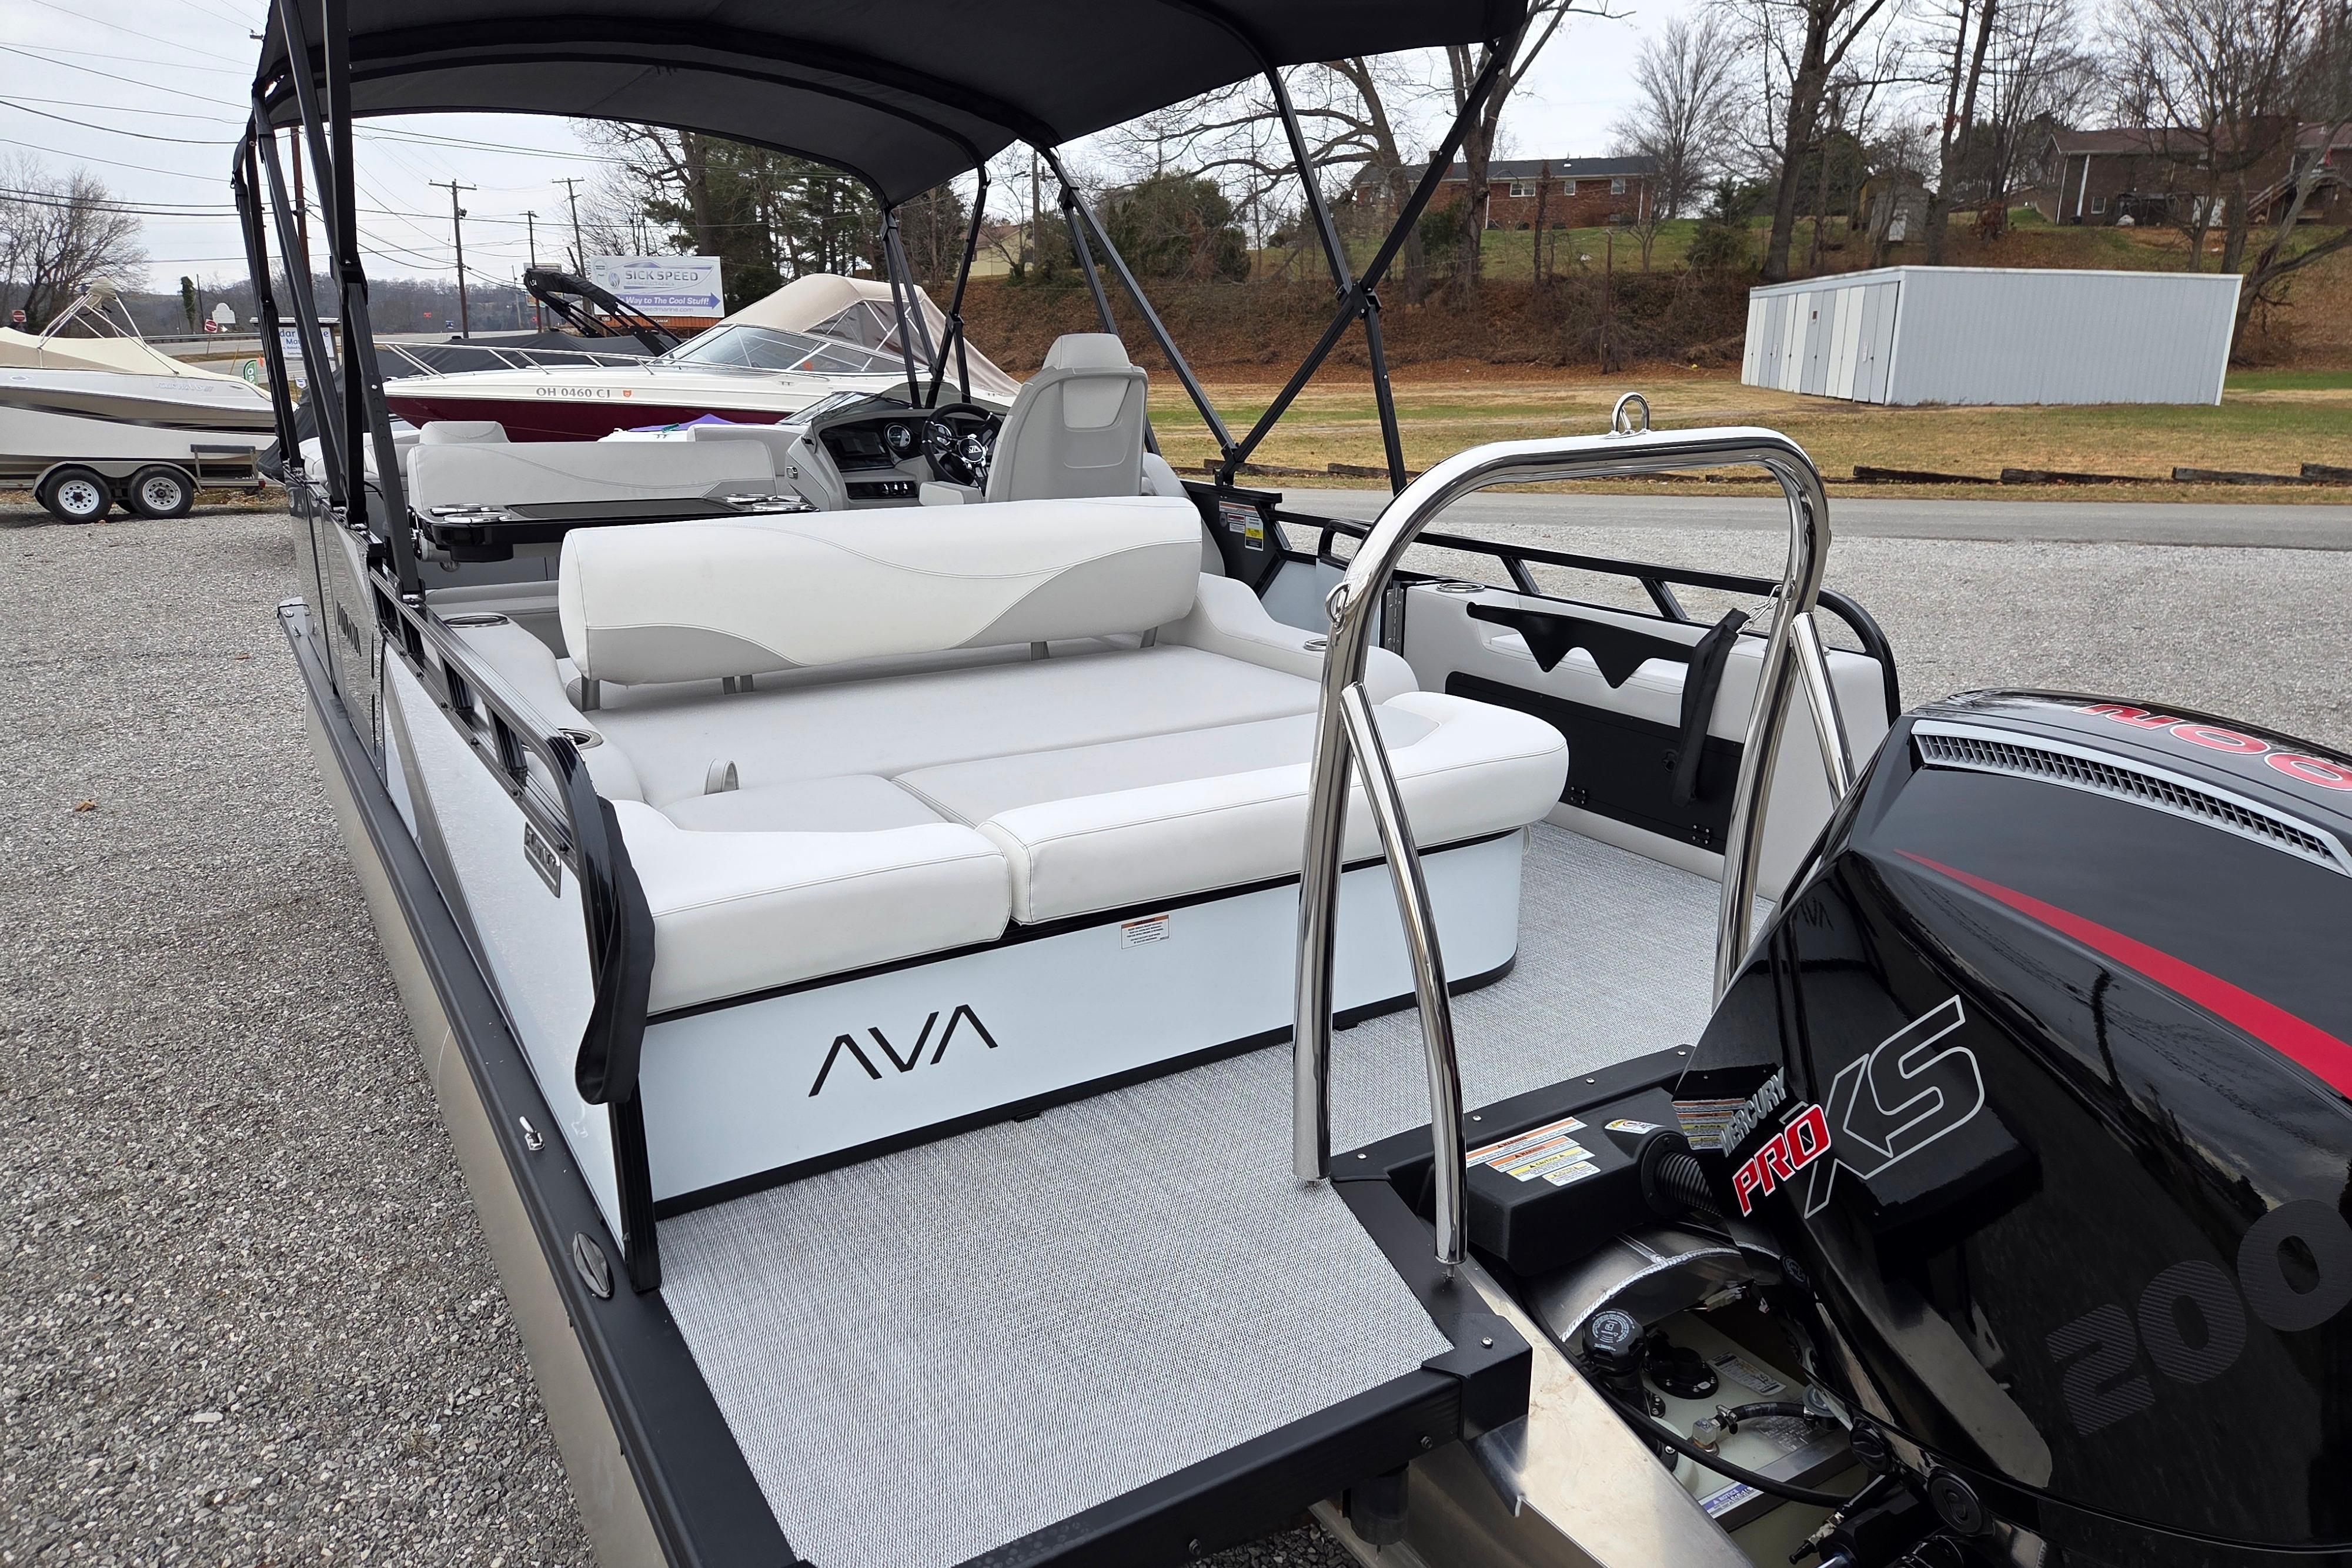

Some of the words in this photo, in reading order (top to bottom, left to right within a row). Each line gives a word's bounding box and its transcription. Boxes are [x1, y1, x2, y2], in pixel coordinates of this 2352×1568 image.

[625, 270, 654, 280] SICK
[657, 271, 699, 281] SPEED
[626, 296, 643, 305] Way
[687, 297, 709, 305] Stuff!
[279, 329, 295, 337] dar
[536, 387, 556, 396] OH
[561, 388, 592, 397] 0460
[596, 389, 610, 398] CJ
[808, 1004, 998, 1098] AVA
[1720, 1066, 1786, 1158] MERCURY
[1779, 995, 1985, 1219] XS
[1502, 1136, 1528, 1147] WARNING
[1732, 1104, 1831, 1217] PRO
[2045, 1198, 2352, 1437] 200
